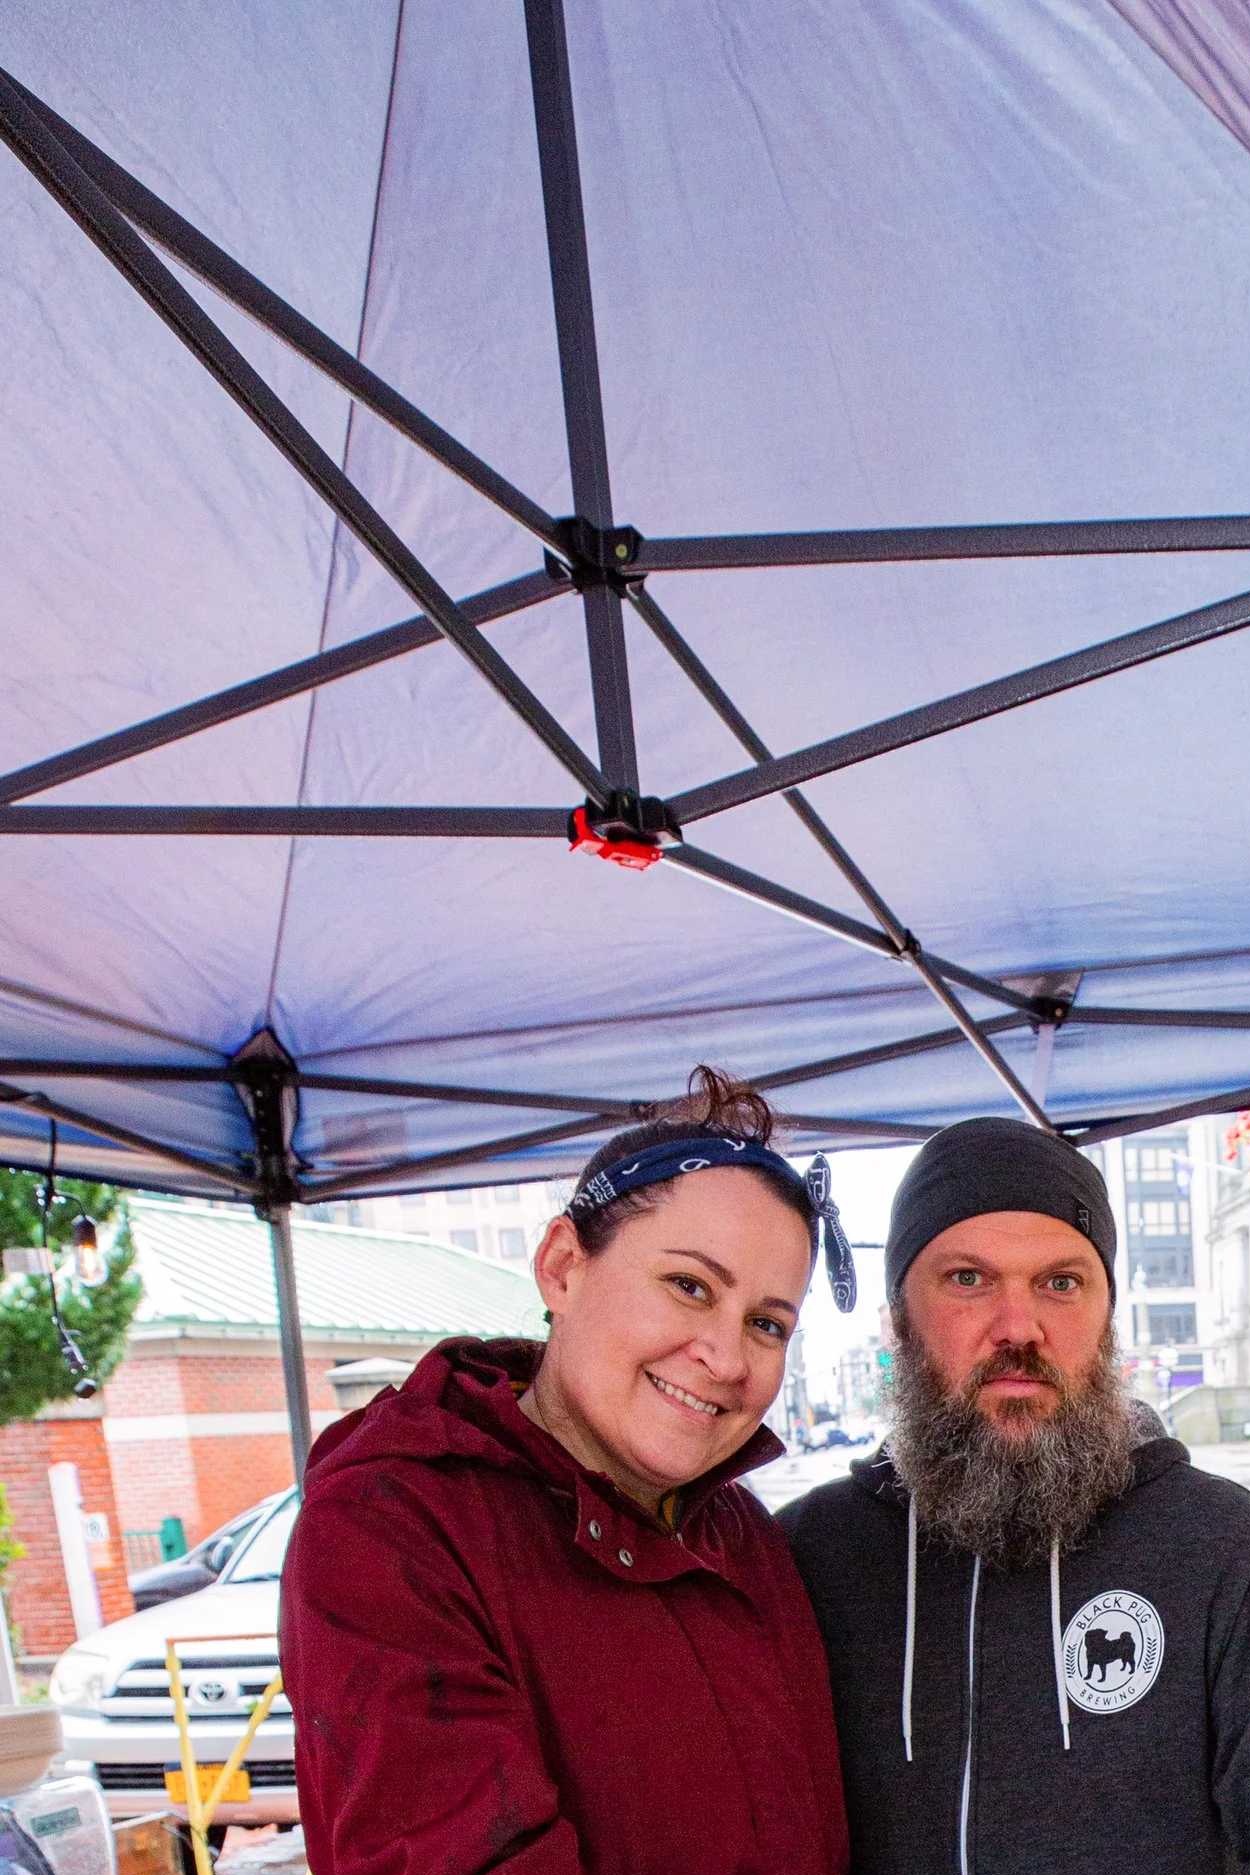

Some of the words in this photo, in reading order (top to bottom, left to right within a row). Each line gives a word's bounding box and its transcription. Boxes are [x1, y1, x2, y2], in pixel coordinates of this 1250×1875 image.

[1076, 1596, 1122, 1630] BLACK
[1128, 1601, 1152, 1624] PUG
[1079, 1686, 1136, 1706] BREWING
